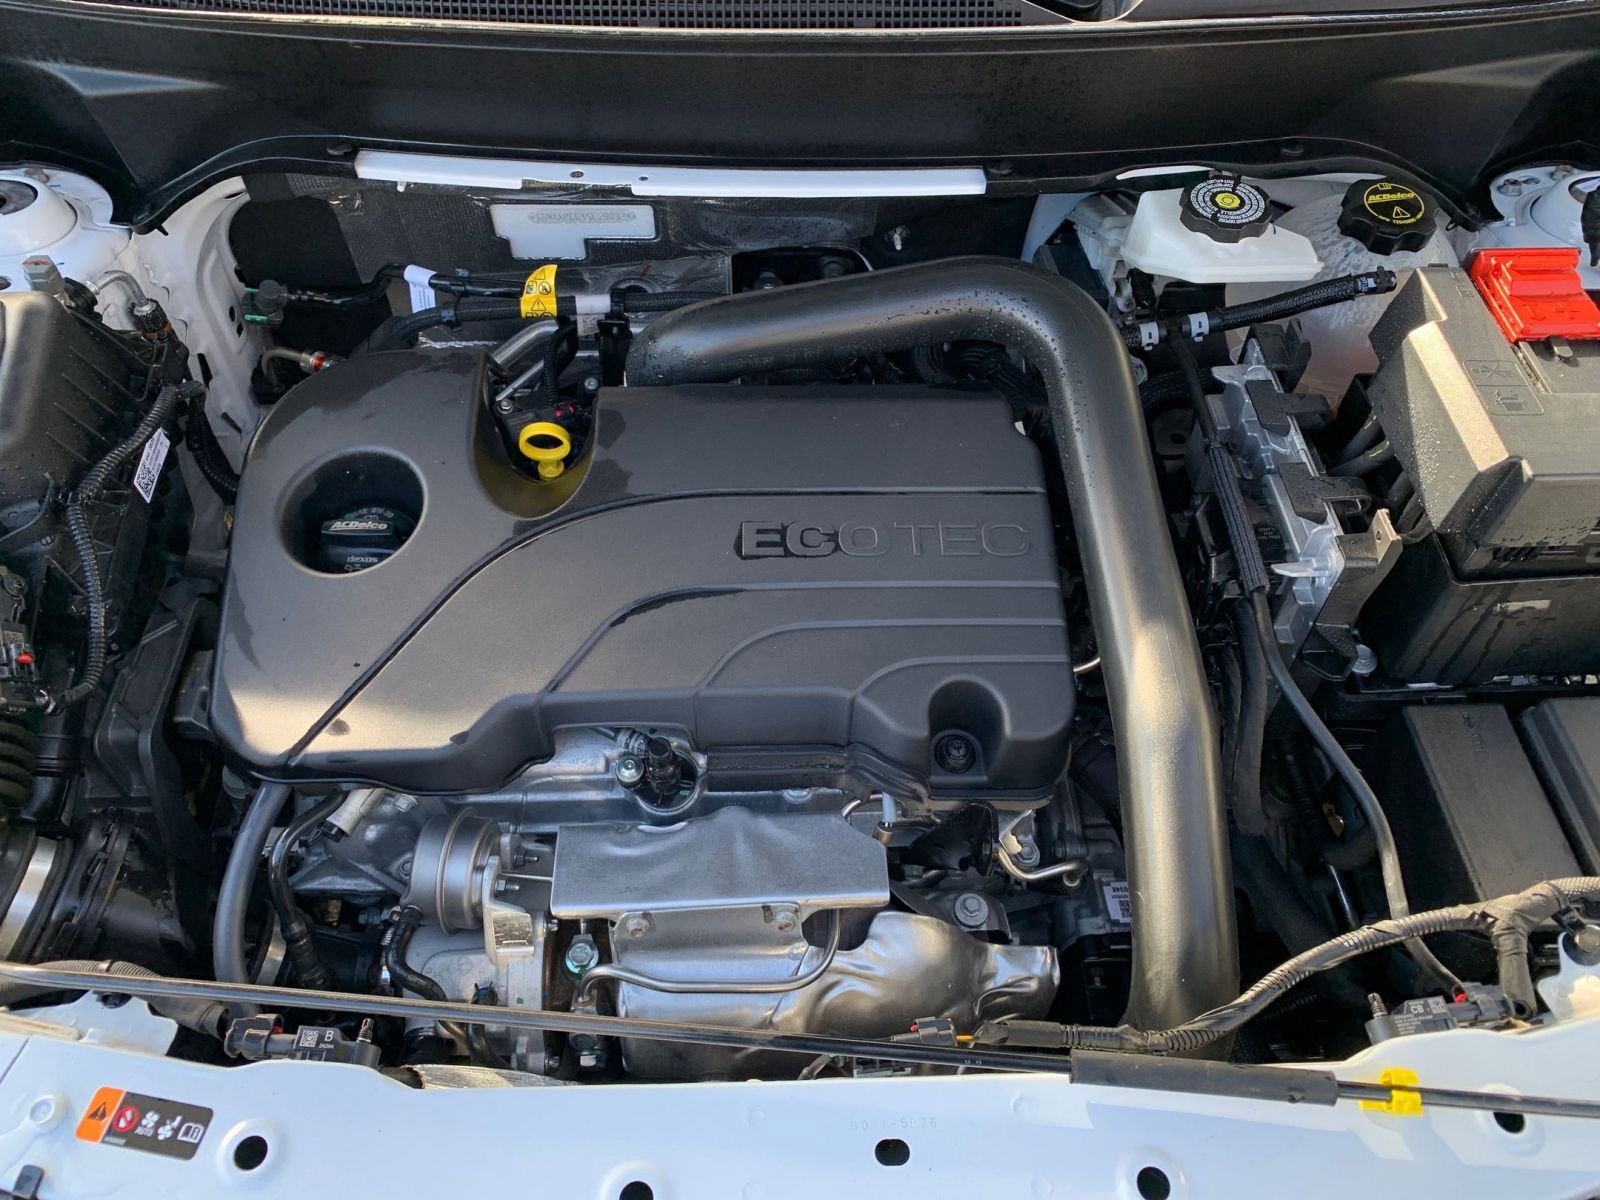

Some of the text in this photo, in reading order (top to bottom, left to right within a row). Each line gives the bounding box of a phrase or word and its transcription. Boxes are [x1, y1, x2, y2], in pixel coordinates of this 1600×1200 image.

[1368, 192, 1415, 203] ACDelco
[330, 521, 388, 530] ACDelco
[741, 520, 1029, 558] ECOTEC
[346, 555, 379, 563] dexos
[1410, 1004, 1425, 1014] CB
[324, 1030, 334, 1042] B
[134, 1126, 154, 1137] AUTO
